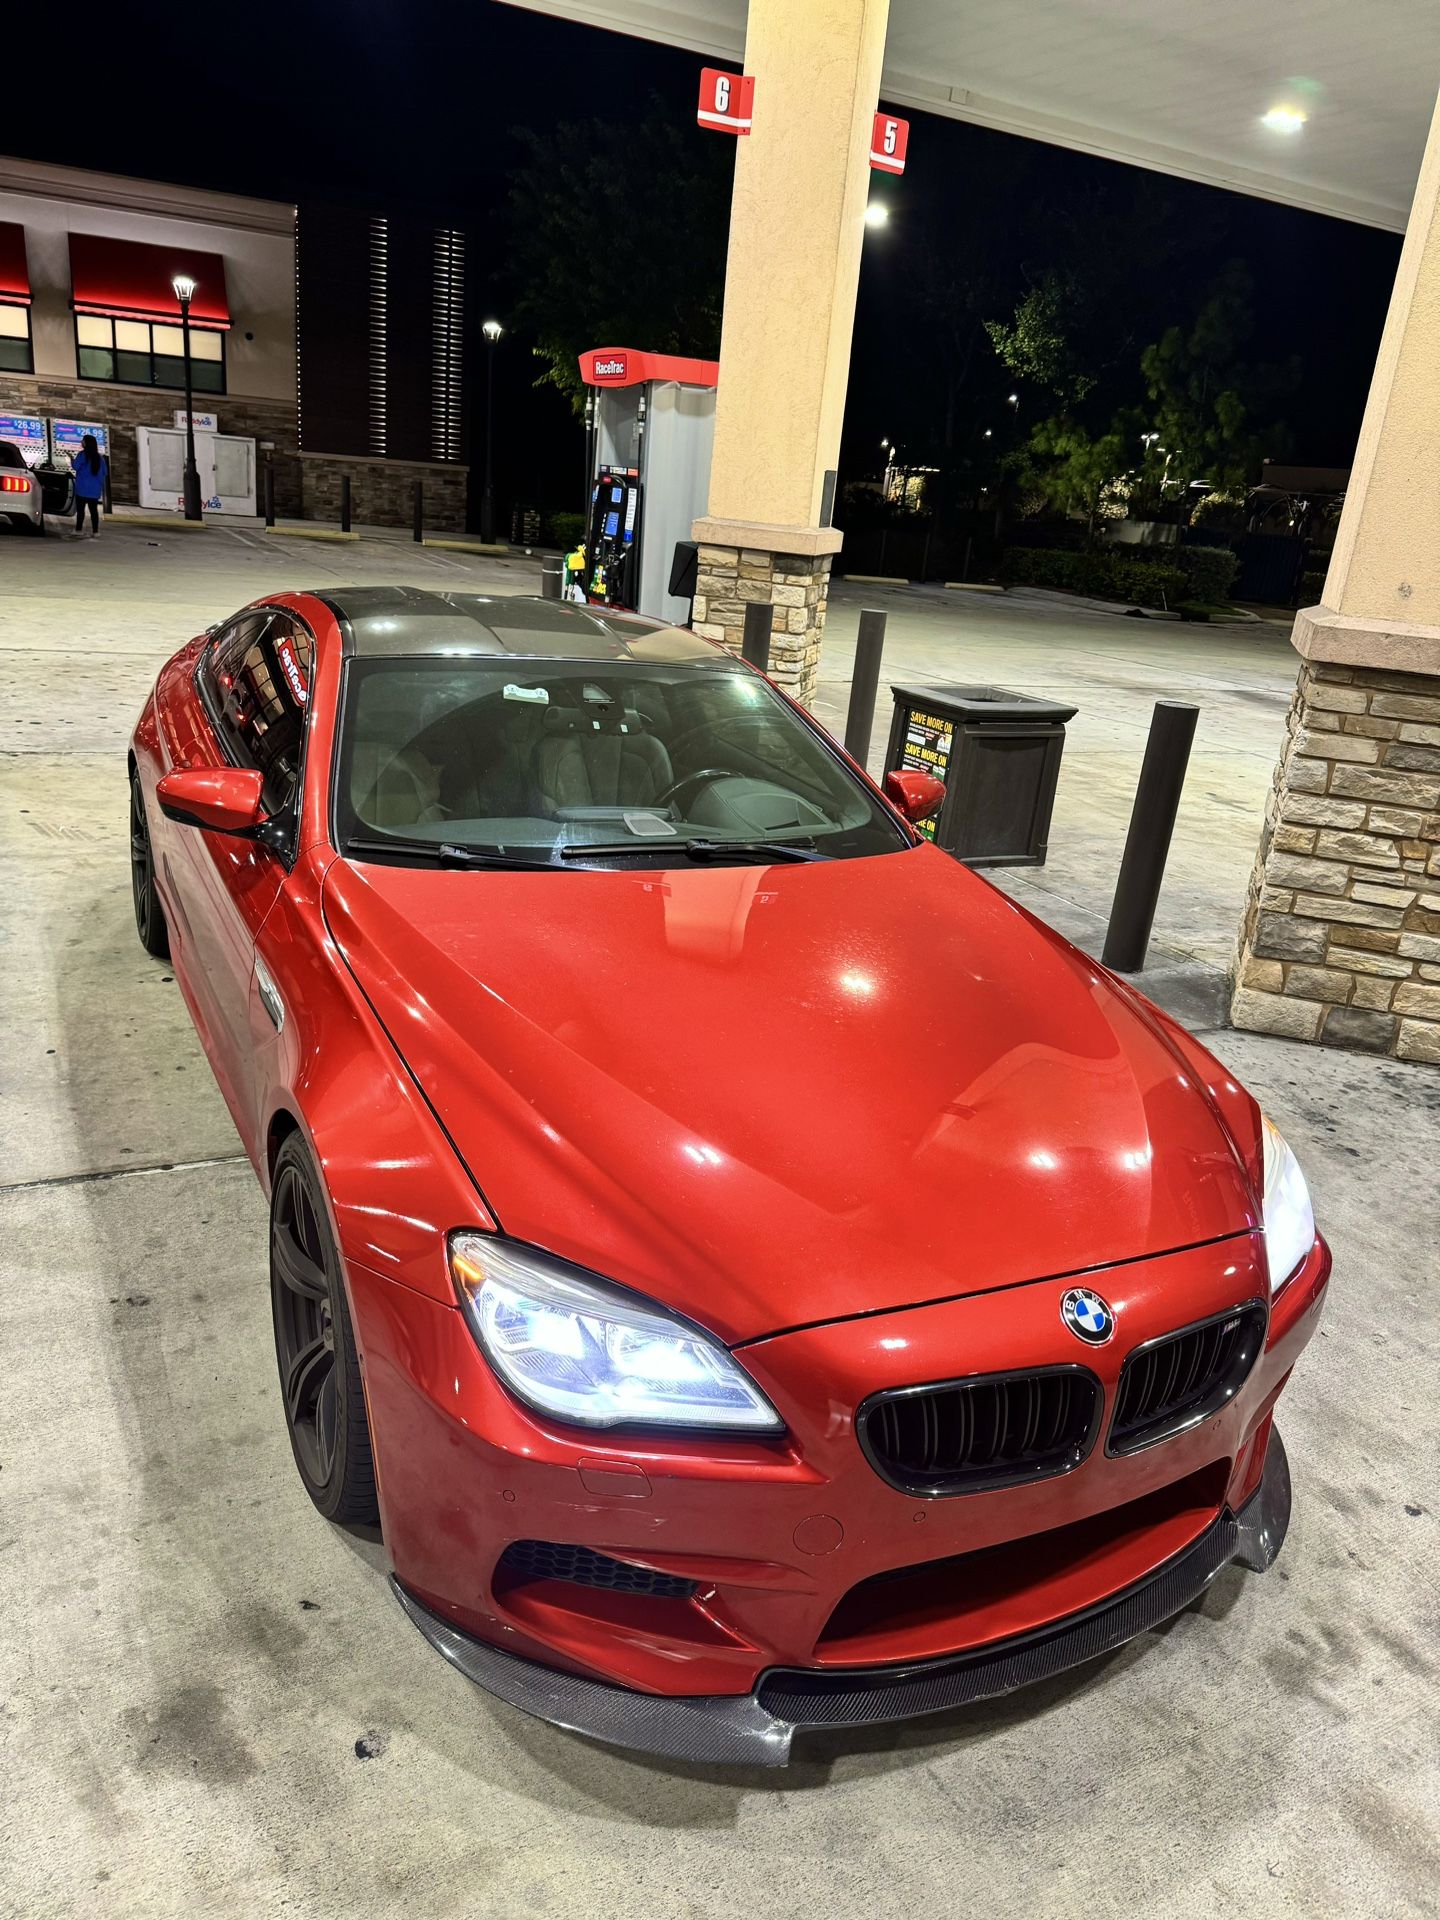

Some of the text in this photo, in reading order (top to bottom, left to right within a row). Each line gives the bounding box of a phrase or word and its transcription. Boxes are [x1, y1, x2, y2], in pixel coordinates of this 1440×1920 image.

[715, 76, 730, 112] 6
[883, 120, 898, 154] 5
[595, 360, 624, 375] RaceTrac
[14, 419, 41, 431] $26.99
[910, 711, 927, 726] SAVE
[926, 715, 944, 731] MORE
[944, 722, 953, 734] ON
[905, 743, 921, 757] SAVE
[921, 748, 938, 763] MORE
[938, 755, 947, 767] ON
[927, 820, 936, 833] ON
